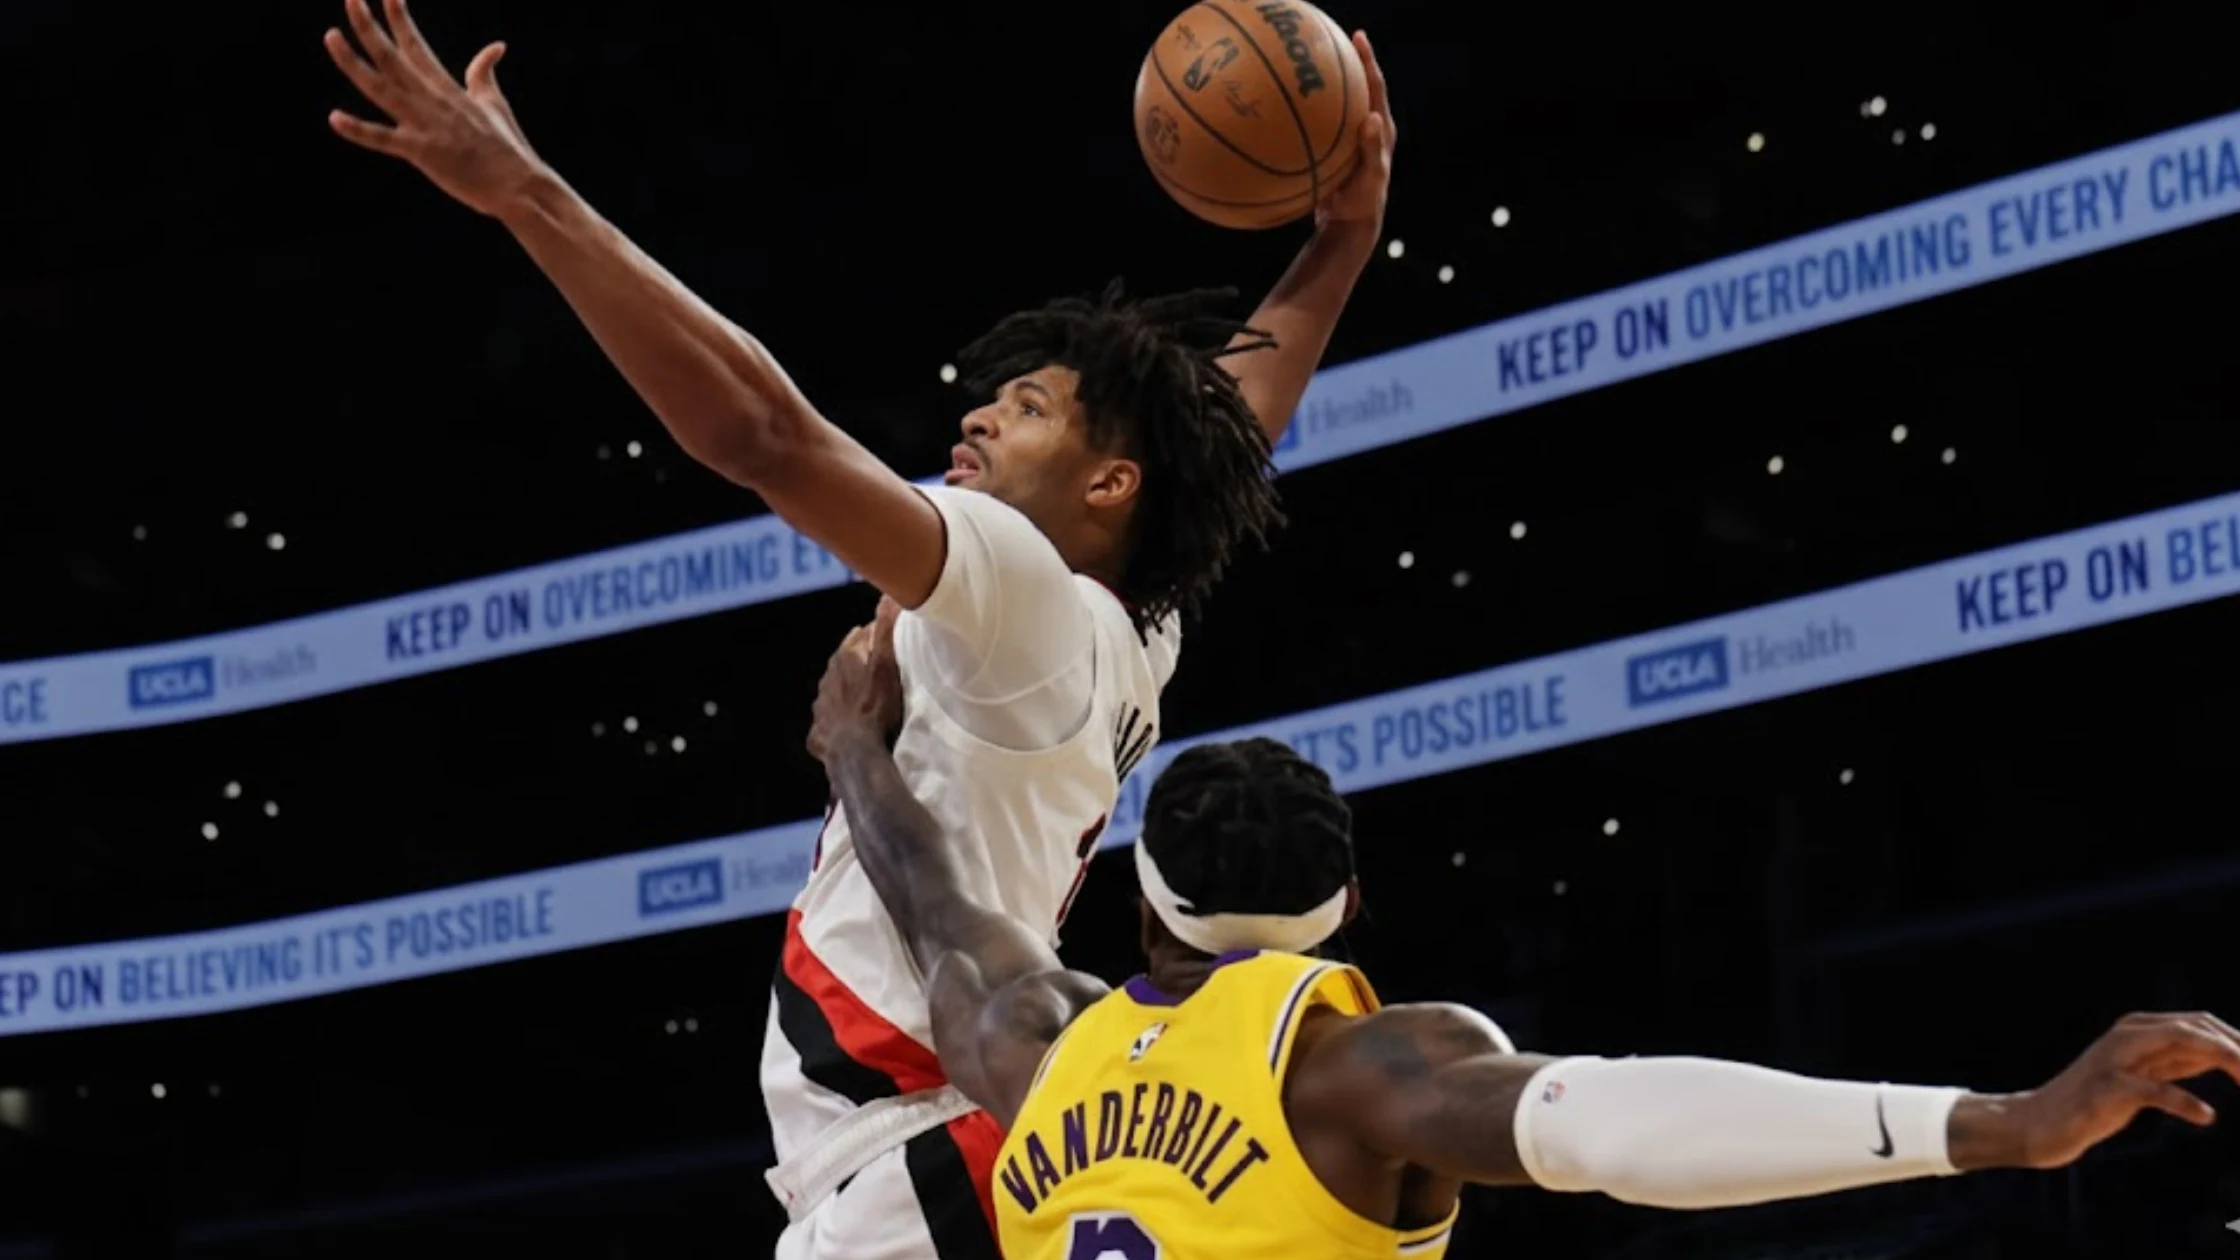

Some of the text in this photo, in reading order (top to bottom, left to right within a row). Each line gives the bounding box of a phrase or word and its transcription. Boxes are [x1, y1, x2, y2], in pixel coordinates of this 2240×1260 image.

[1497, 318, 1598, 394] KEEP
[1614, 297, 1670, 360] ON
[1684, 213, 1971, 341] OVERCOMING
[1988, 167, 2129, 257] EVERY
[386, 602, 472, 662] KEEP
[484, 588, 531, 642] ON
[543, 532, 780, 630] OVERCOMING
[1955, 558, 2069, 633] KEEP
[2086, 537, 2149, 604] ON
[134, 662, 209, 702] UCLA
[1635, 617, 1856, 697] UCLA Health
[1373, 674, 1567, 768] POSSIBLE
[645, 868, 717, 907] UCLA
[54, 963, 104, 1012] ON
[117, 936, 303, 1003] BELIEVING
[313, 922, 375, 978] IT'S
[386, 888, 555, 964] POSSIBLE
[1000, 1081, 1270, 1214] VANDERBILT
